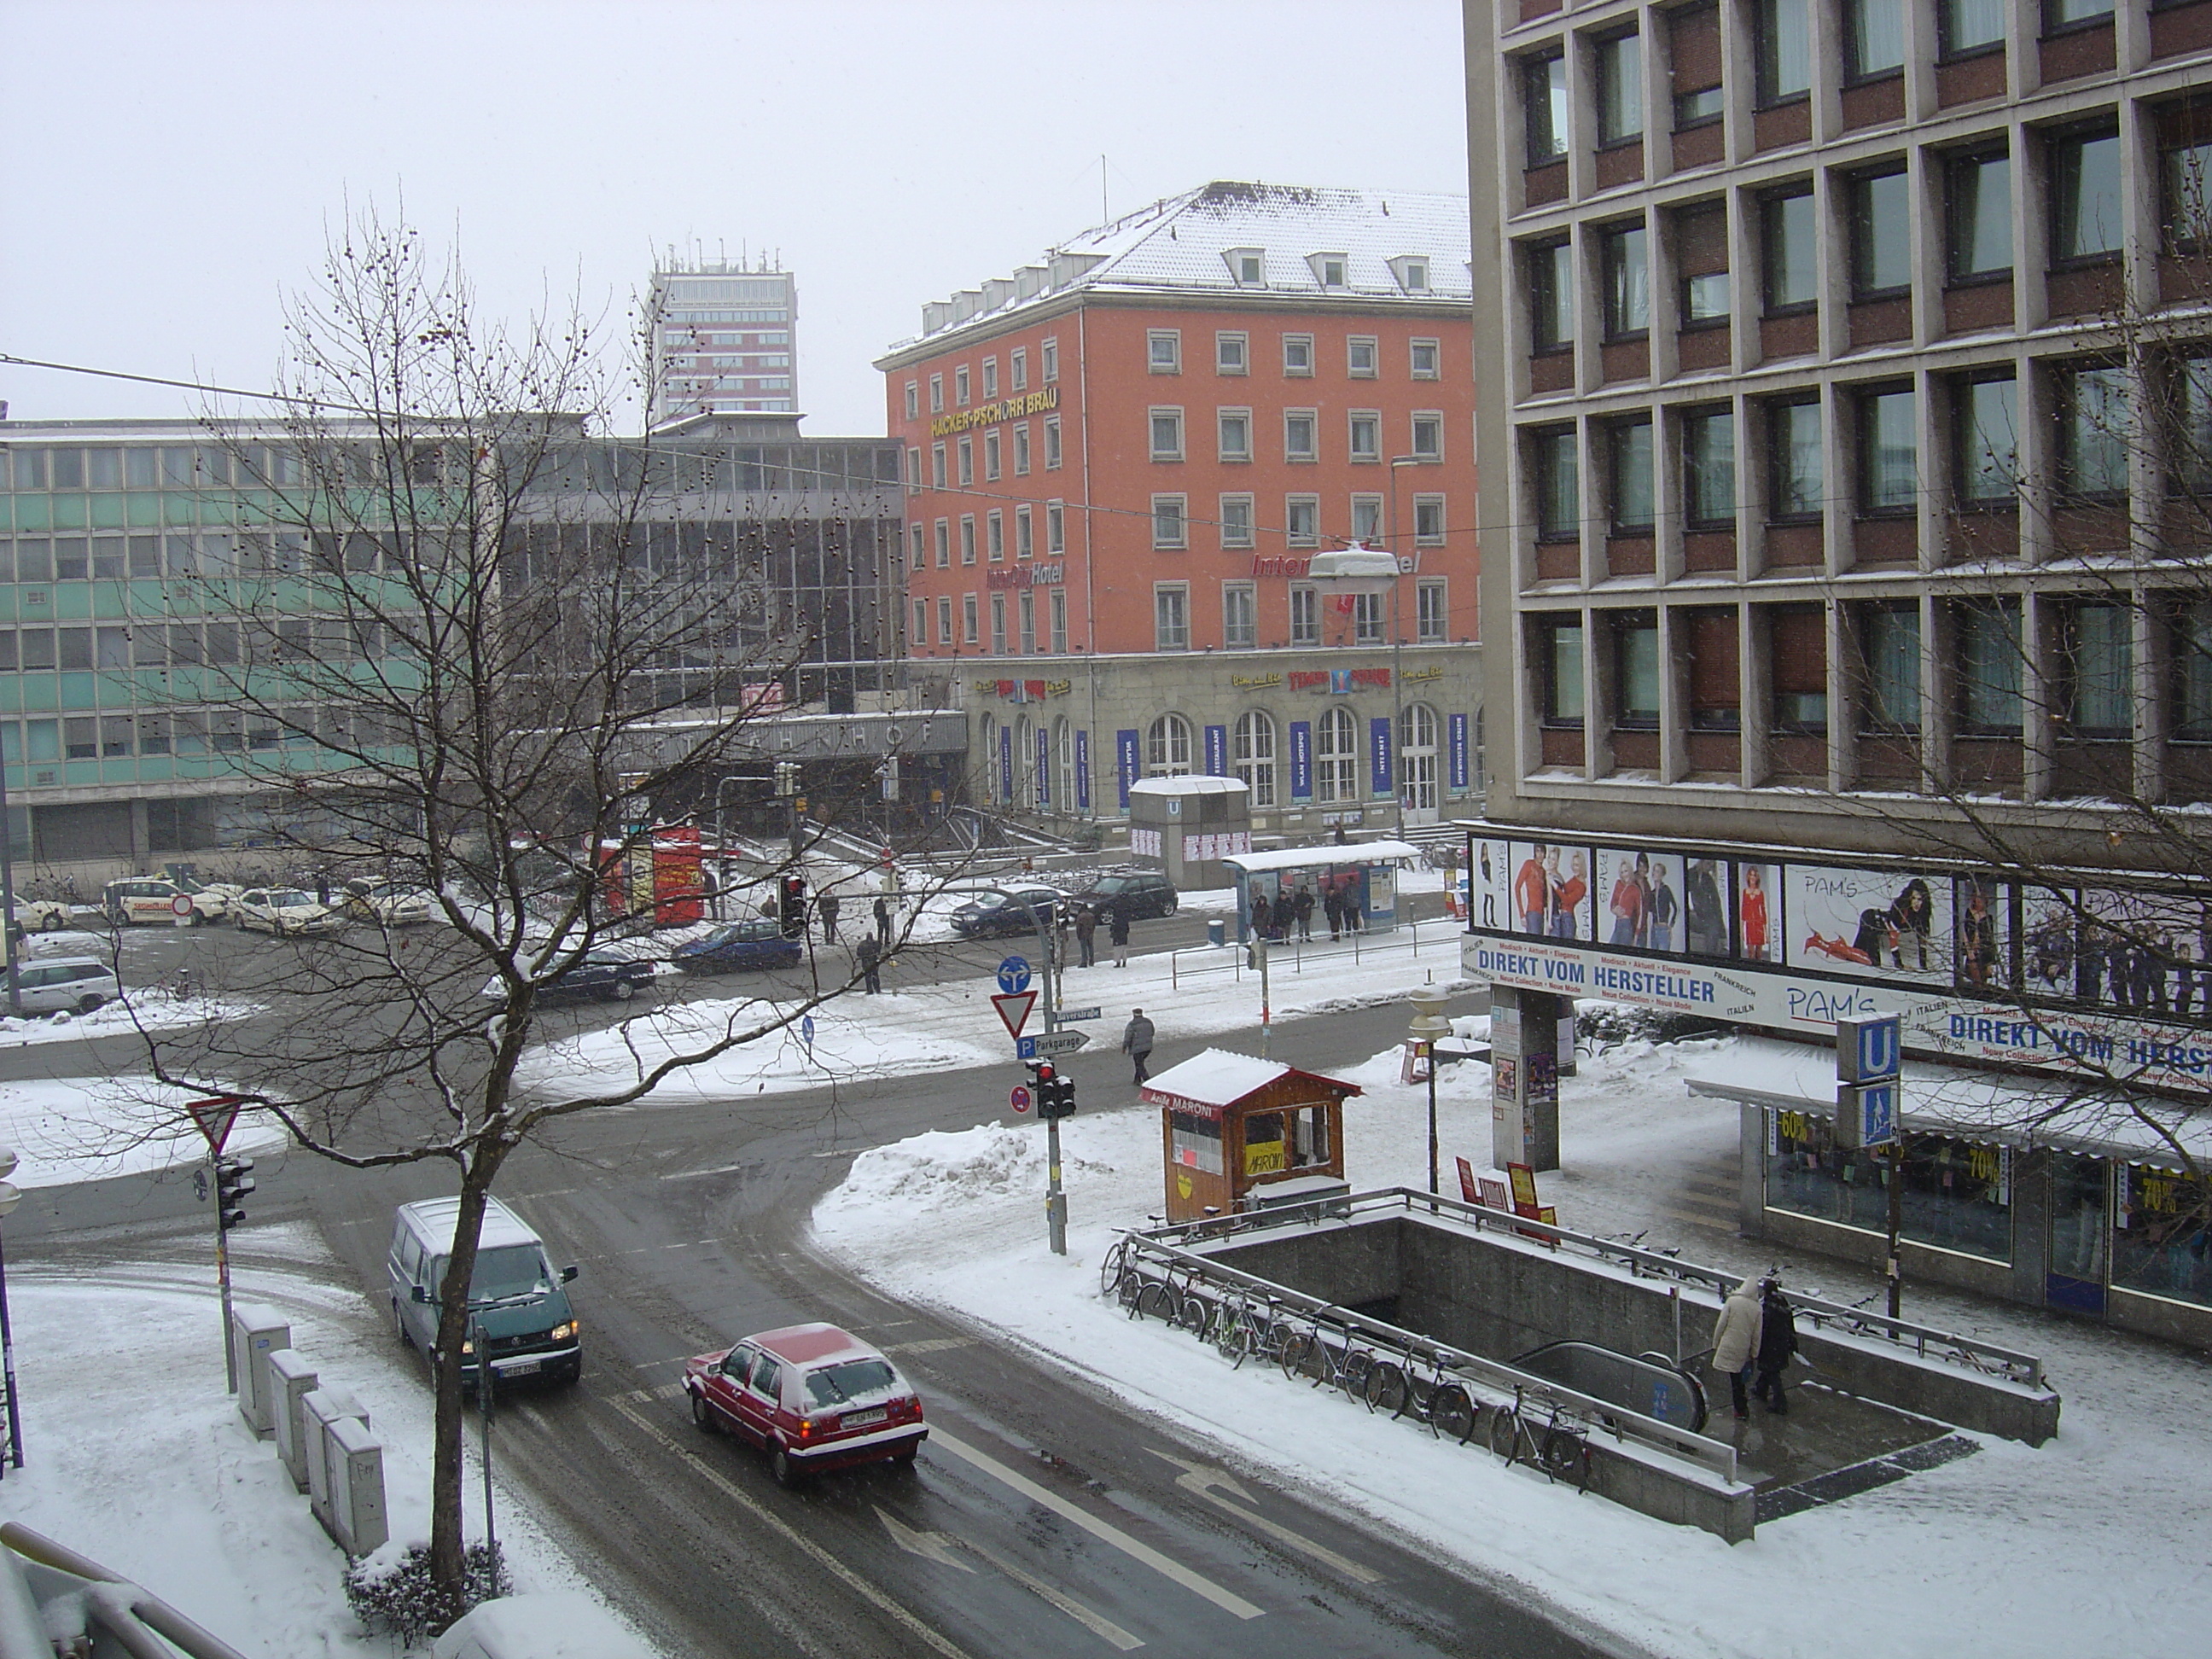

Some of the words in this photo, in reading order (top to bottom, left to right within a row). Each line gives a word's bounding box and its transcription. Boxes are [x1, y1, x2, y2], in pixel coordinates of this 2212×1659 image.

[1027, 386, 1057, 415] BRÄU
[1169, 802, 1179, 814] U
[1804, 876, 1858, 898] PAM'S
[1499, 942, 1522, 952] Modisch
[1528, 946, 1549, 956] Aktuell
[1554, 950, 1580, 960] Elegance
[1601, 956, 1627, 966] Modisch
[1633, 960, 1656, 970] Aktuell
[1662, 964, 1691, 975] Elegance
[1479, 950, 1539, 976] DIREKT
[1544, 959, 1585, 983] VOM
[1594, 966, 1715, 1003] HERSTELLER
[1515, 976, 1543, 987] Collection
[1549, 982, 1563, 991] Neue
[1565, 984, 1581, 992] Mode
[1714, 970, 1756, 997] FRANKREICH
[1602, 990, 1618, 999] Neue
[1619, 992, 1650, 1004] Collection
[1656, 998, 1673, 1008] Neue
[1674, 1001, 1691, 1010] Mode
[1787, 987, 1876, 1021] PAM'S
[1916, 1000, 1949, 1016] ITALIEN
[1022, 1041, 1032, 1056] P
[1036, 1037, 1080, 1051] Parkgarage
[1950, 1014, 2041, 1049] DIREKT
[2052, 1028, 2114, 1061] VOM
[1865, 1026, 1891, 1074] U
[1173, 1097, 1212, 1118] MARONI
[1248, 1153, 1283, 1173] MARONI
